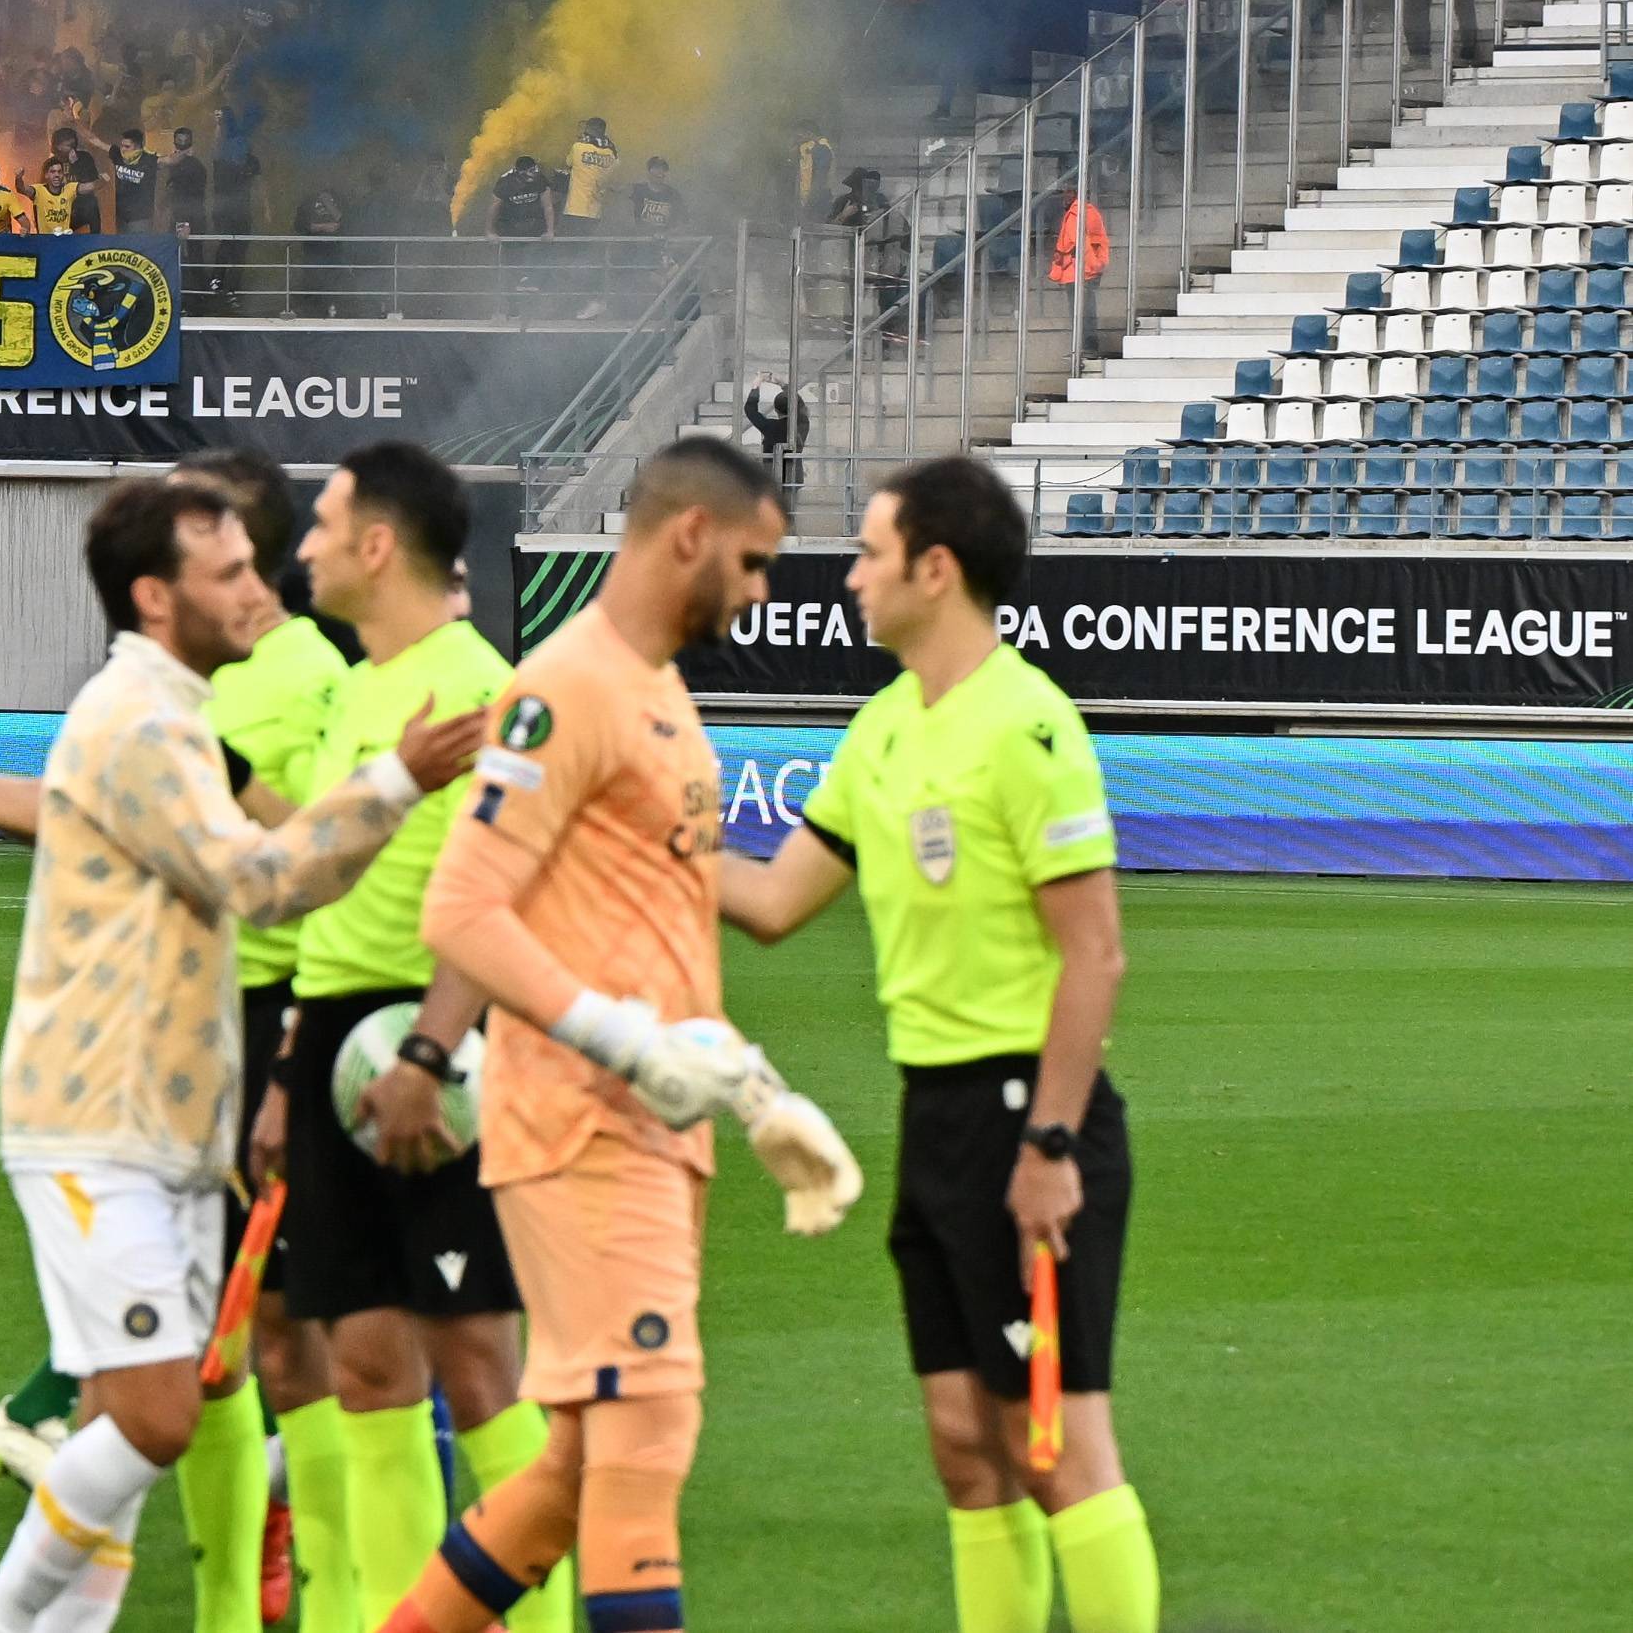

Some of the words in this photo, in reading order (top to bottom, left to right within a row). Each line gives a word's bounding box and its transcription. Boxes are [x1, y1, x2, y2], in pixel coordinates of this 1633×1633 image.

[97, 251, 144, 269] MACCABI
[142, 264, 168, 304] FANATICS
[66, 340, 89, 359] GROUP
[132, 345, 150, 357] GATE
[149, 321, 166, 347] ELEVEN
[730, 602, 854, 648] UEFA
[1062, 603, 1397, 655] CONFERENCE
